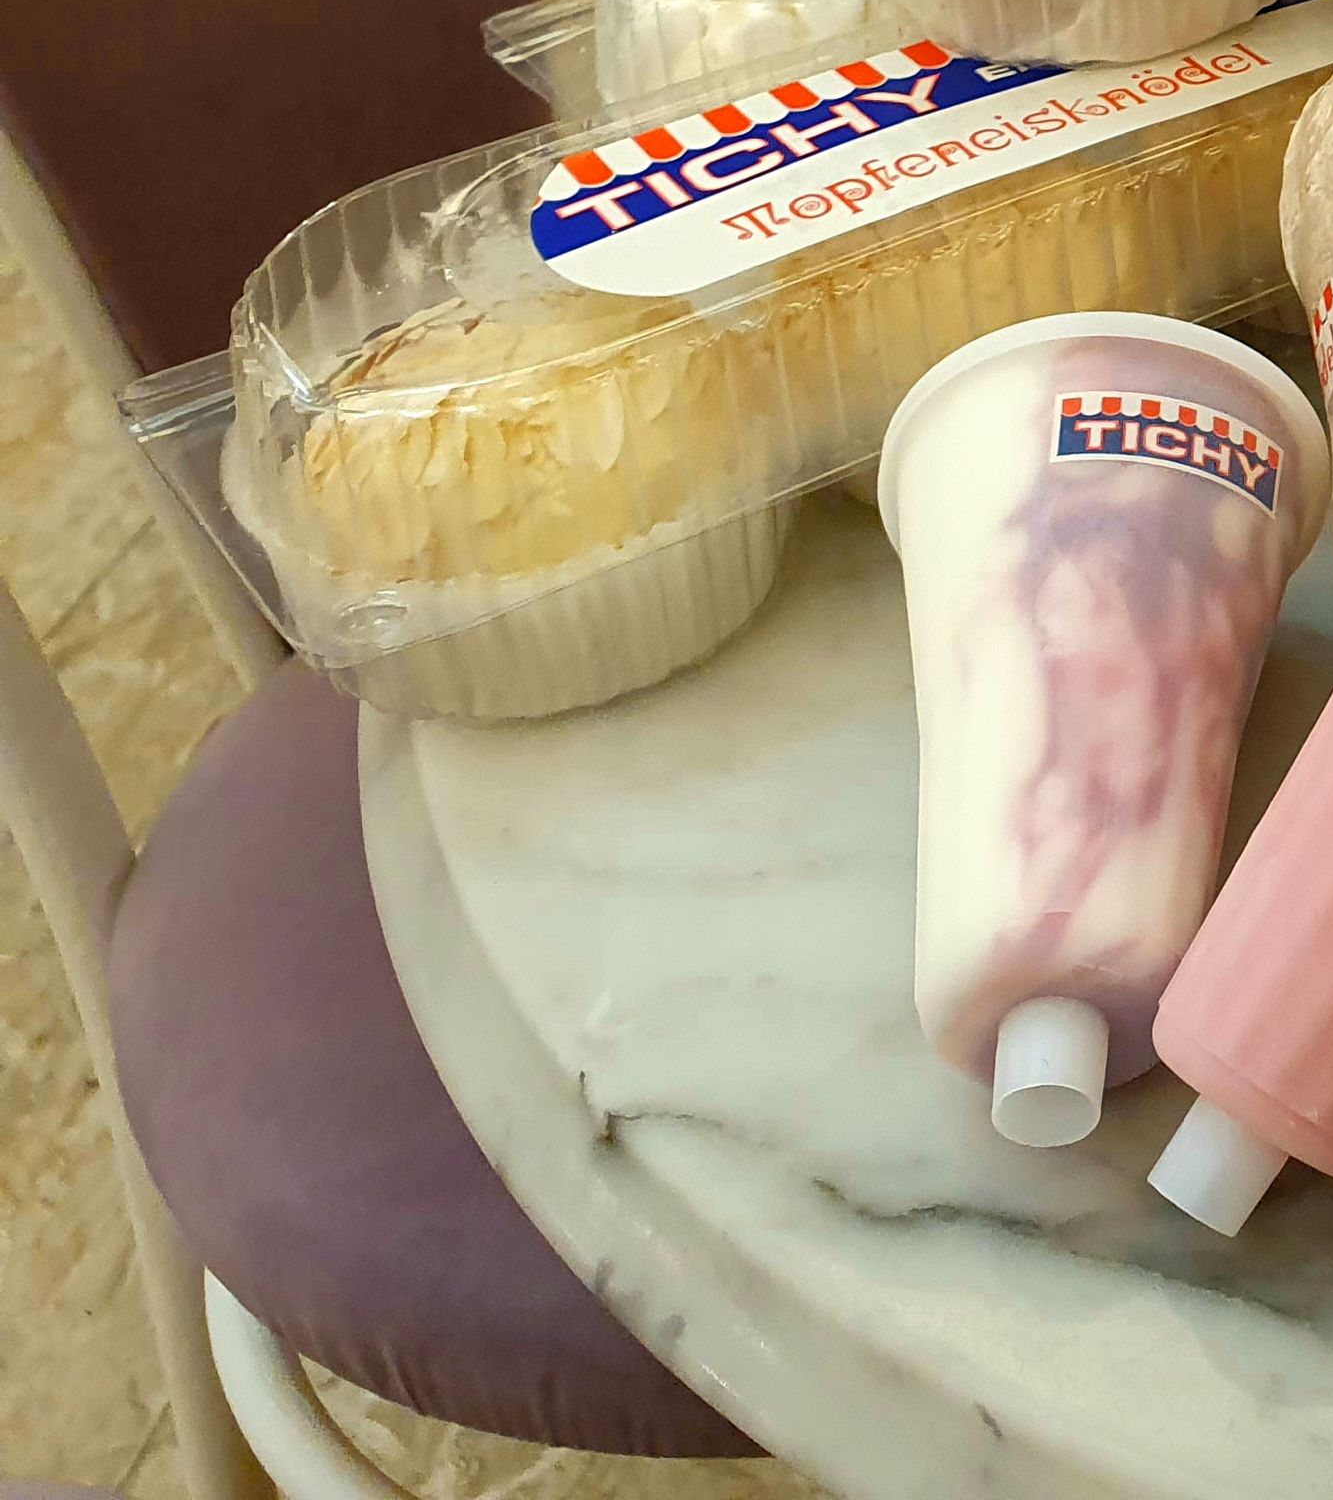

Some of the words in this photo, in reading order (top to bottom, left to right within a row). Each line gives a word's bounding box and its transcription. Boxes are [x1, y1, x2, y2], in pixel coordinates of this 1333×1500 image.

[554, 72, 947, 235] TICHY
[720, 42, 1273, 241] Topfeneisknödel
[1073, 419, 1271, 492] TICHY
